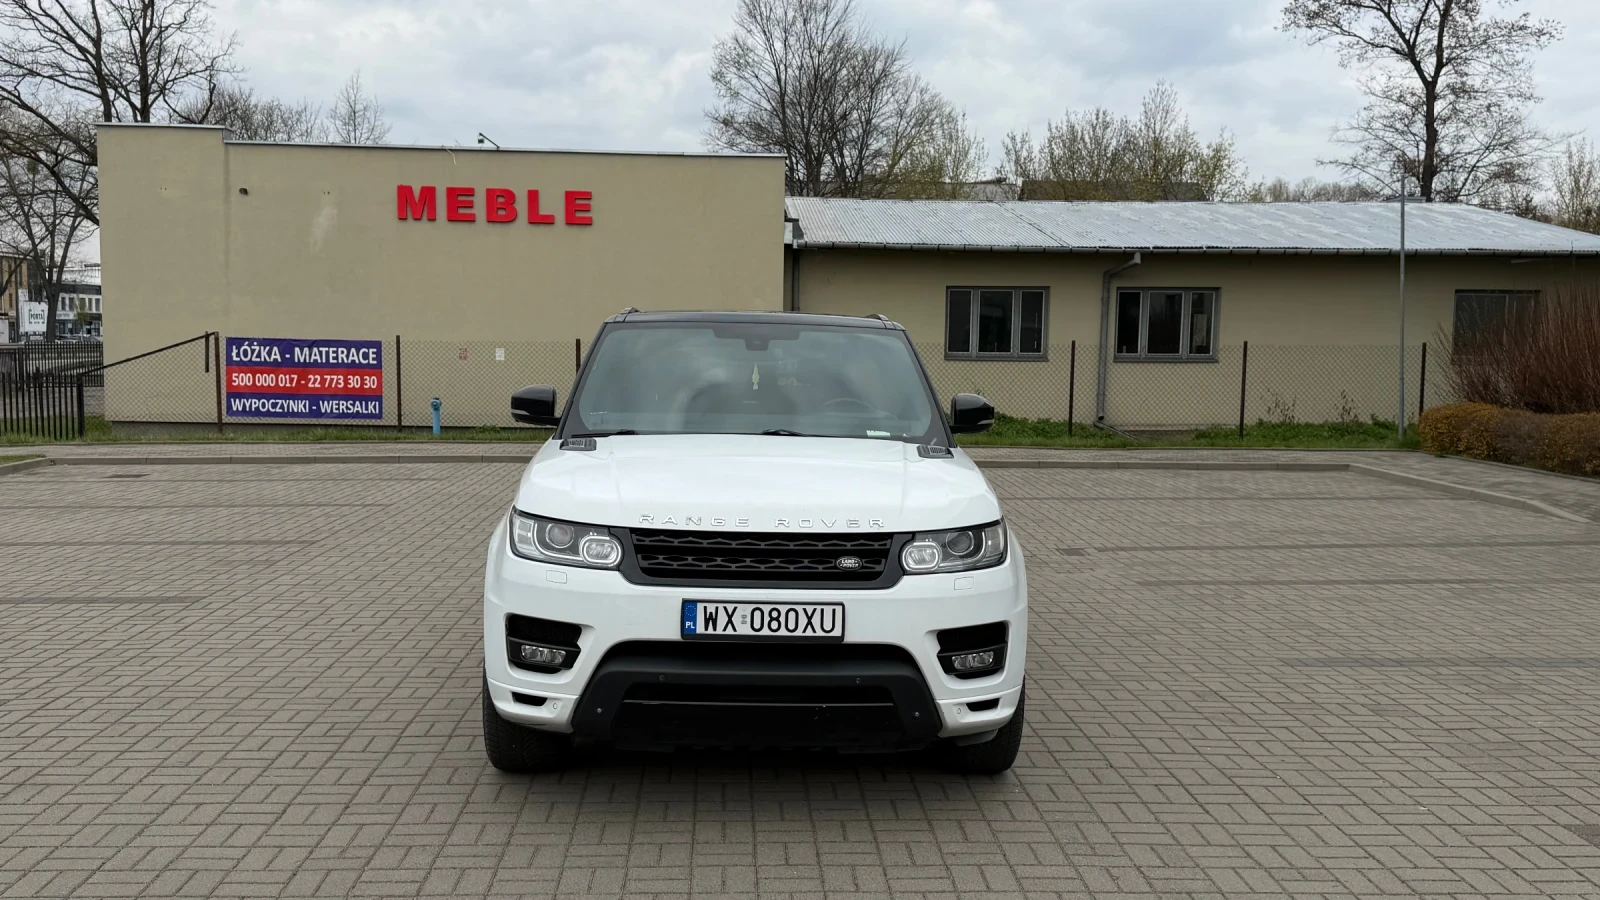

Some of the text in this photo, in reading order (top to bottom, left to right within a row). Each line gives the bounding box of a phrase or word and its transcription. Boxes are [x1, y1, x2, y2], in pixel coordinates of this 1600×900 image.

[397, 184, 593, 225] MEBLE
[231, 341, 281, 362] ŁÓŻKA
[294, 347, 377, 364] MATERACE
[231, 373, 253, 386] 500
[255, 373, 276, 387] 000
[278, 374, 298, 387] 017
[307, 375, 321, 388] 22
[323, 375, 344, 388] 773
[347, 375, 361, 388] 30
[363, 376, 378, 389] 30
[231, 398, 309, 413] WYPOCZYNKI
[319, 400, 379, 414] WERSALKI
[638, 513, 885, 529] RANGE ROVER
[685, 621, 695, 629] PL
[703, 605, 836, 634] WX 080XU
